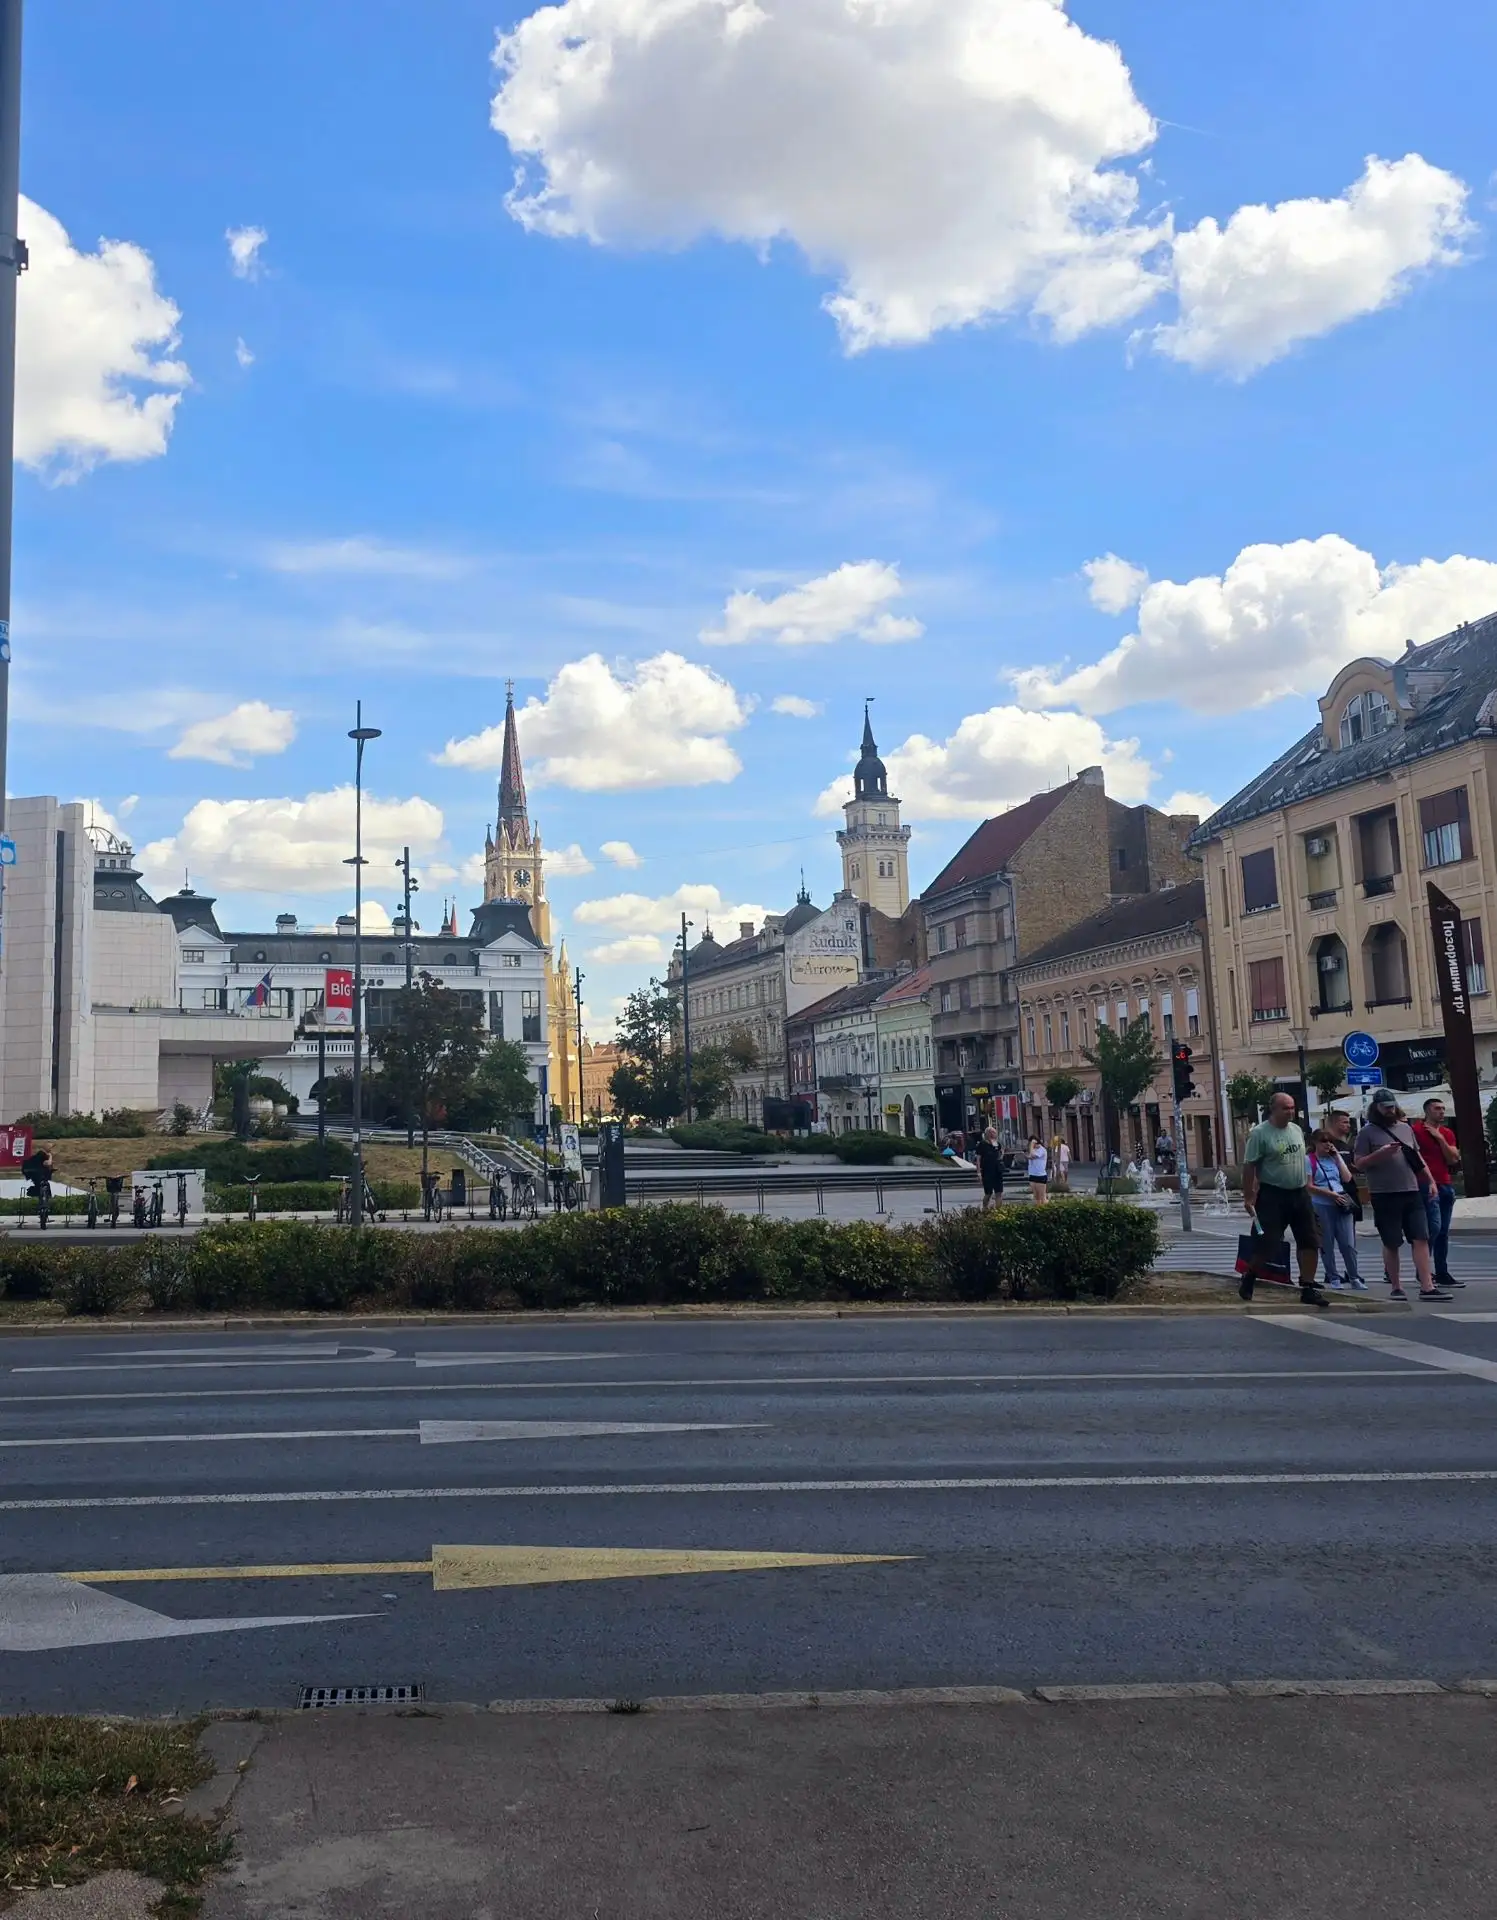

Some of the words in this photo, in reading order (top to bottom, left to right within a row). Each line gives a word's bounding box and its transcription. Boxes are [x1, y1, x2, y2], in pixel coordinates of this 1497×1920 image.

[809, 935, 858, 948] Rudnik
[803, 962, 844, 975] Arrow
[1442, 920, 1462, 992] Позоришни
[1452, 995, 1466, 1015] трг
